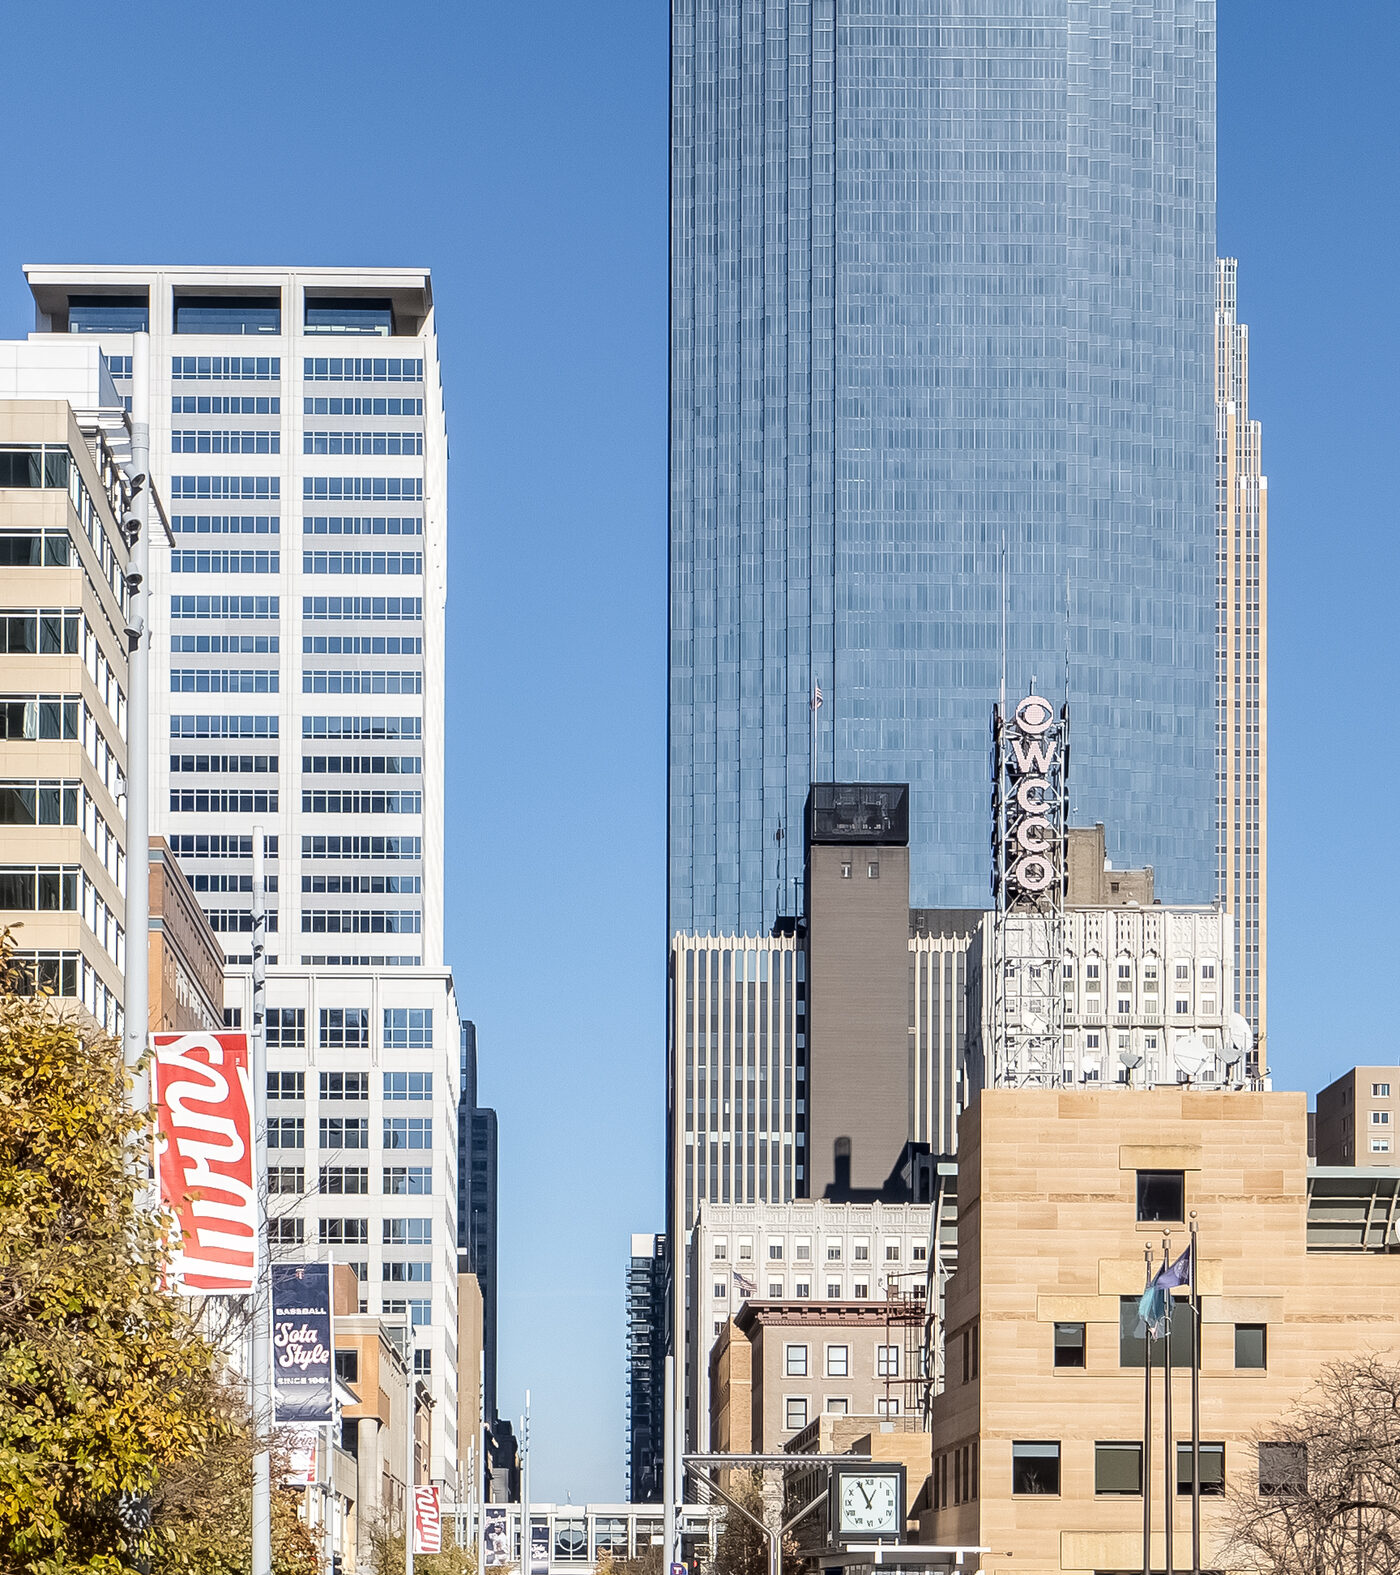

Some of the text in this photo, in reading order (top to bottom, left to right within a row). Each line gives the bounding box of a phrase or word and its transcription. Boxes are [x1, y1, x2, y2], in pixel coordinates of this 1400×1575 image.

[1013, 740, 1058, 892] WCCO
[276, 1307, 327, 1316] BASEBALL
[279, 1343, 330, 1371] Style
[277, 1377, 307, 1385] SINCE
